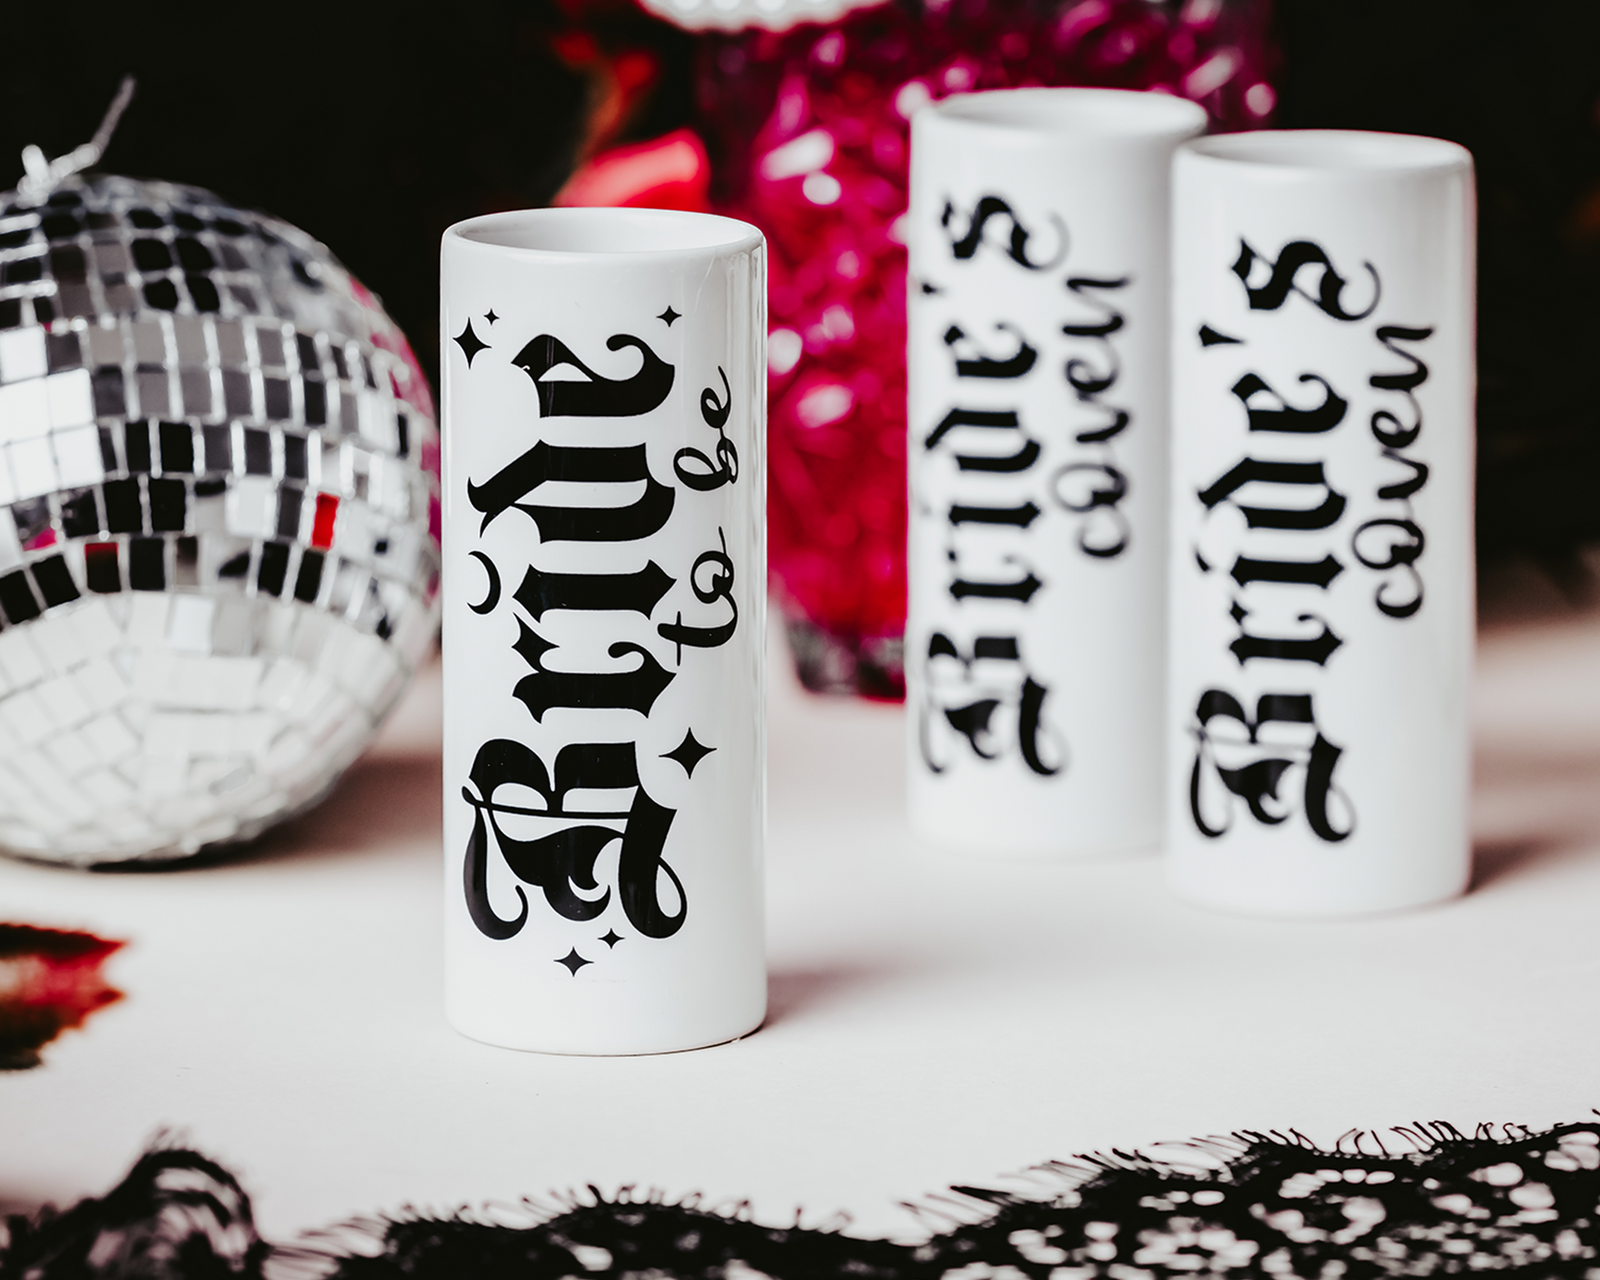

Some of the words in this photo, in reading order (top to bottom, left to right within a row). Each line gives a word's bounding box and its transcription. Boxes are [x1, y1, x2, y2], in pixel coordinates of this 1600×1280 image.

[673, 365, 739, 492] be
[919, 194, 1070, 777] Bride's
[1052, 275, 1134, 560] coven
[1187, 237, 1382, 843] Bride's
[1350, 324, 1435, 619] coven
[461, 333, 688, 940] Bride
[657, 527, 738, 666] to
